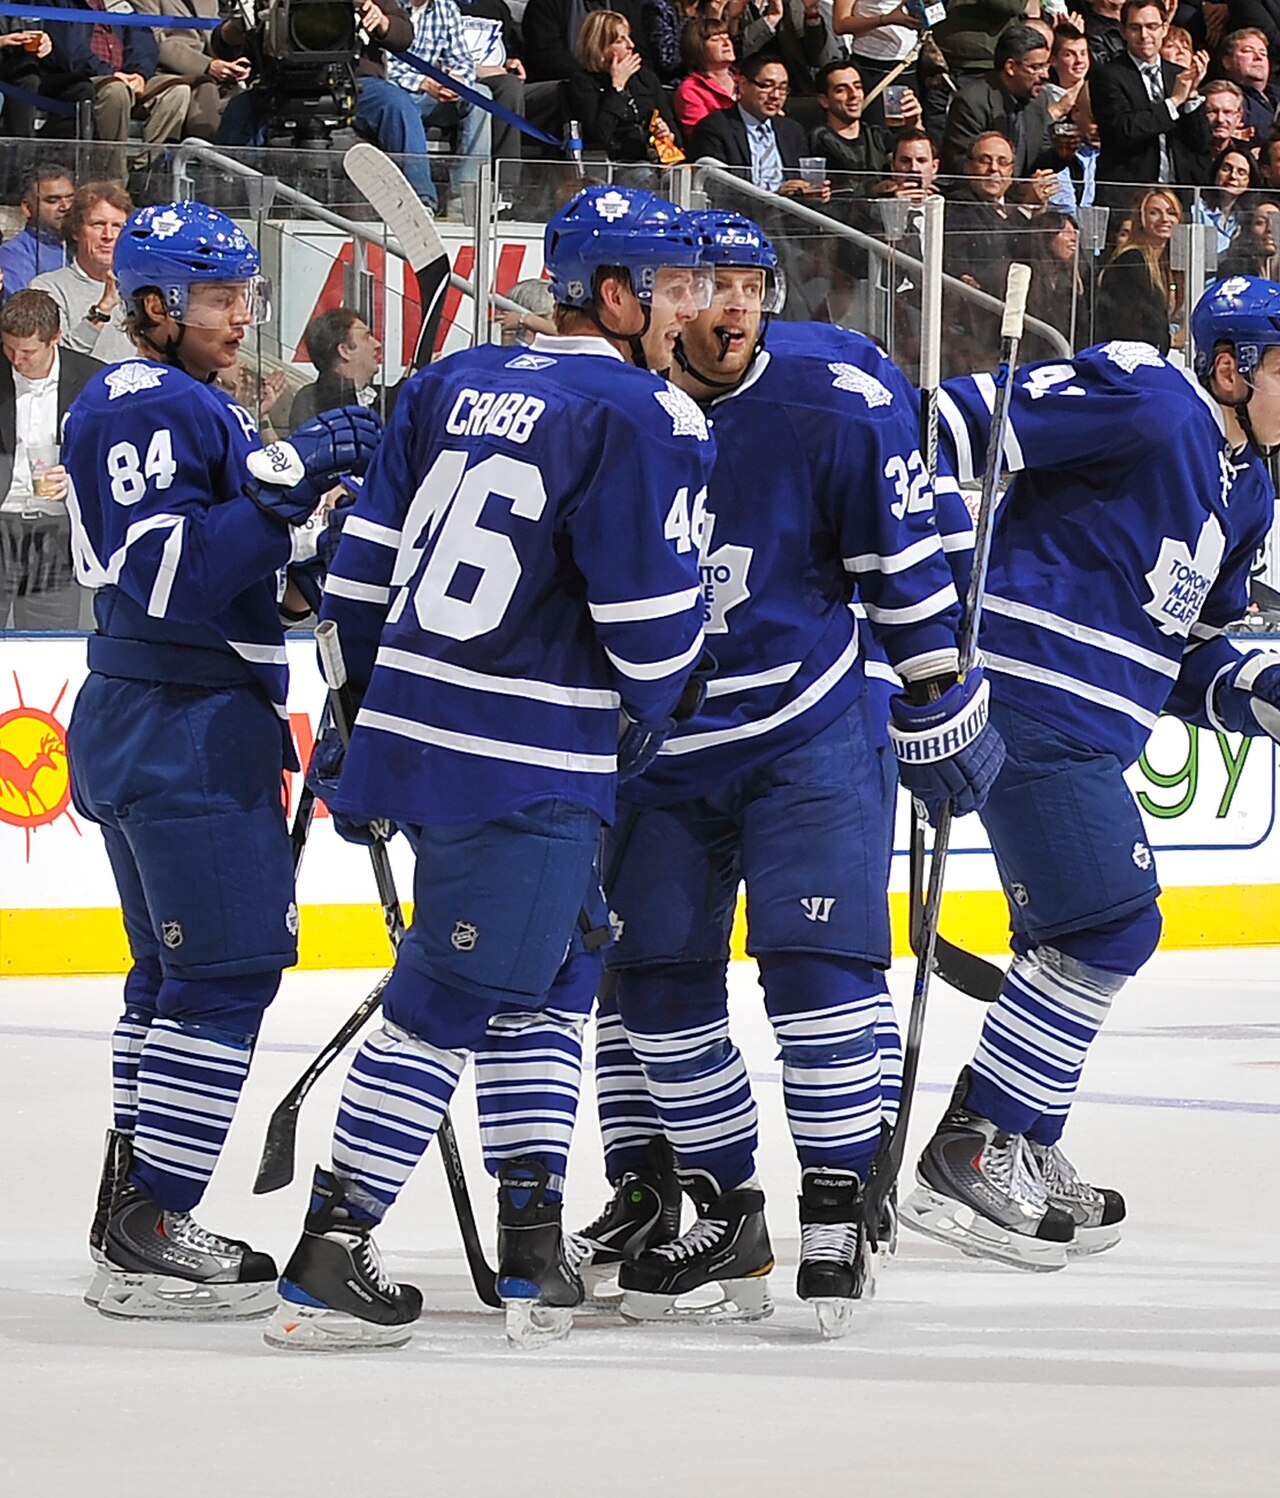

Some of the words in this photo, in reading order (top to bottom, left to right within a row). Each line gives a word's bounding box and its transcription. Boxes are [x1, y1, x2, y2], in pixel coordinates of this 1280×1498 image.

[446, 388, 546, 444] CRABB
[107, 429, 177, 506] 84
[884, 449, 934, 520] 32
[386, 449, 548, 642] 46
[813, 1178, 853, 1188] BAUER
